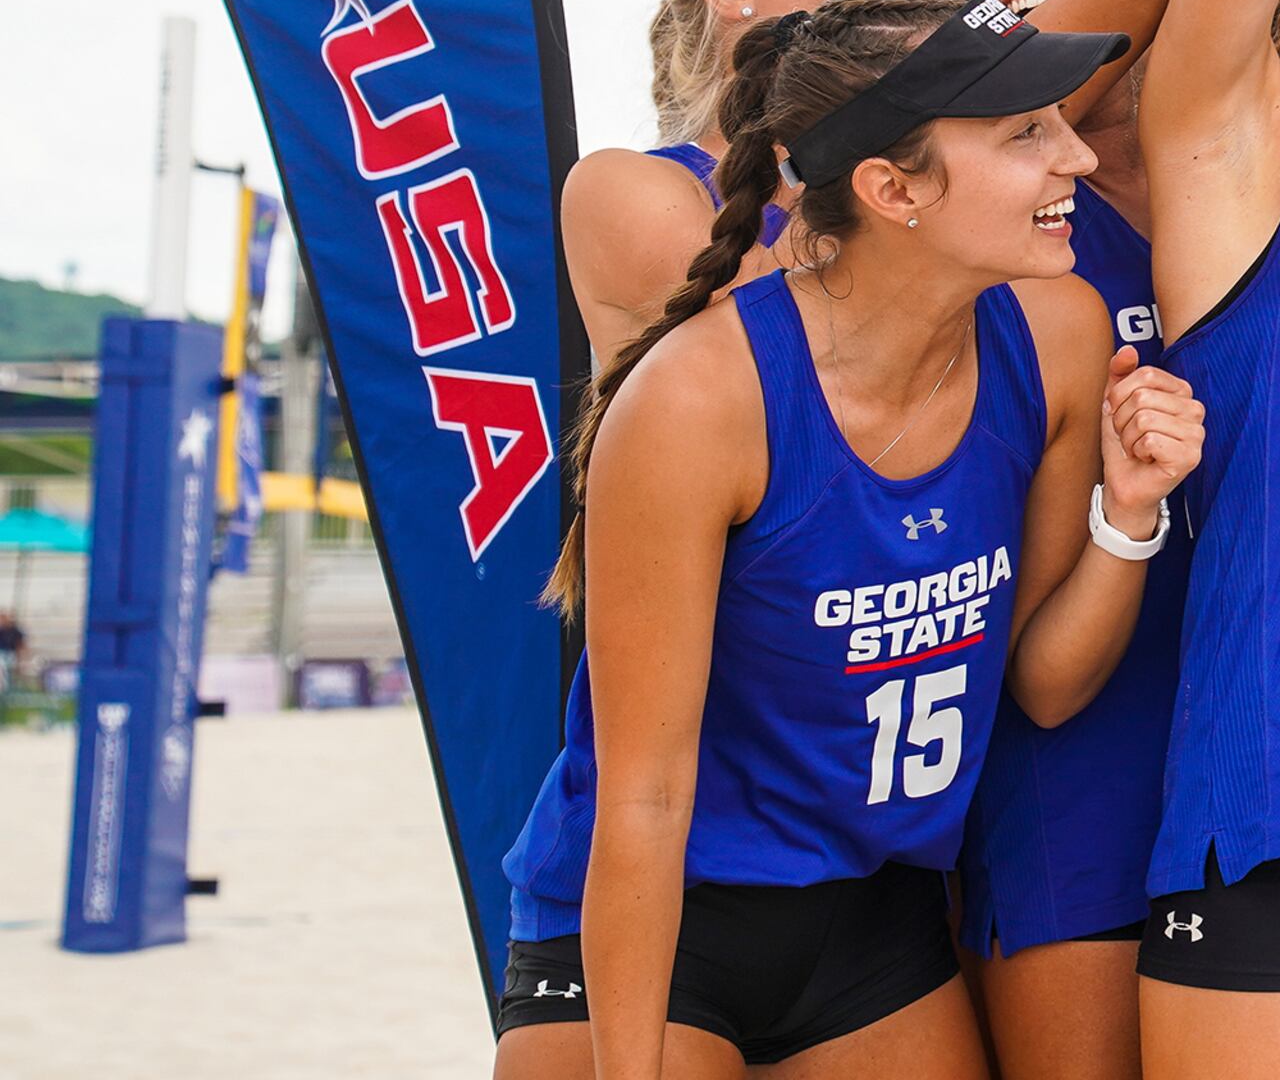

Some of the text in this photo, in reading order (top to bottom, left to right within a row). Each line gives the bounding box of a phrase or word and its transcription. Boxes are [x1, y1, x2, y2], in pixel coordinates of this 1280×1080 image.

[814, 546, 1012, 628] GEORGIA
[847, 594, 990, 665] STATE
[865, 664, 968, 806] 15
